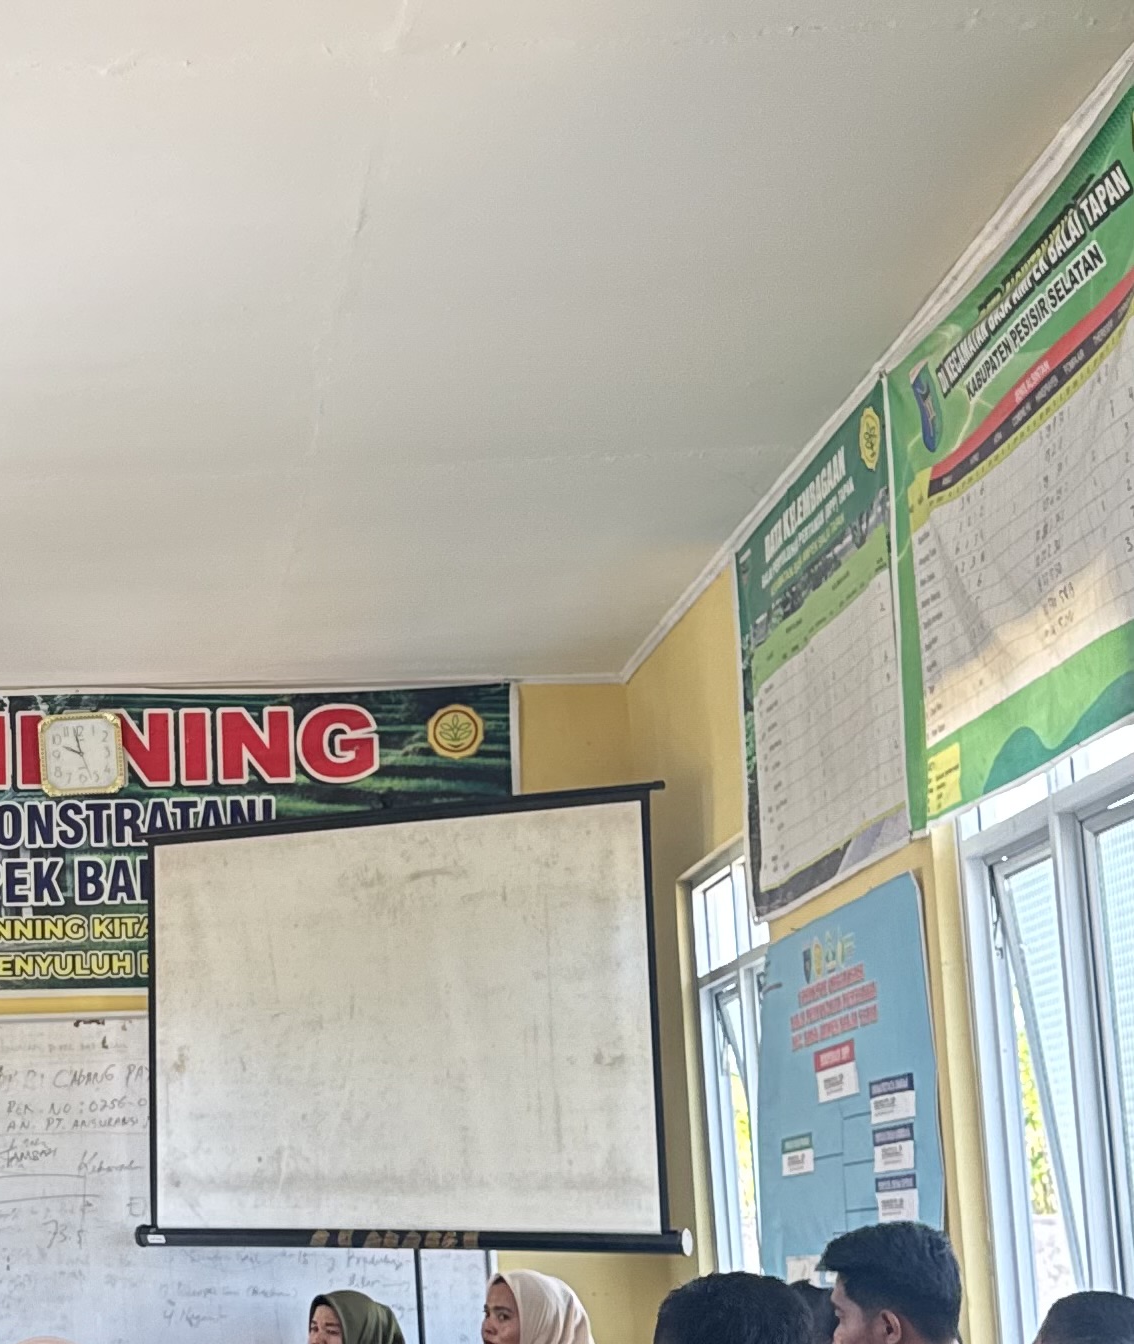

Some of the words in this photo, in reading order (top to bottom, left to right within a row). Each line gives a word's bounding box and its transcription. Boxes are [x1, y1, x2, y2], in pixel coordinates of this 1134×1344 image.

[1079, 165, 1131, 224] TAPAN
[966, 341, 1012, 400] KABUPATEN
[1011, 296, 1049, 346] PESISIR
[1047, 243, 1105, 304] SELATAN
